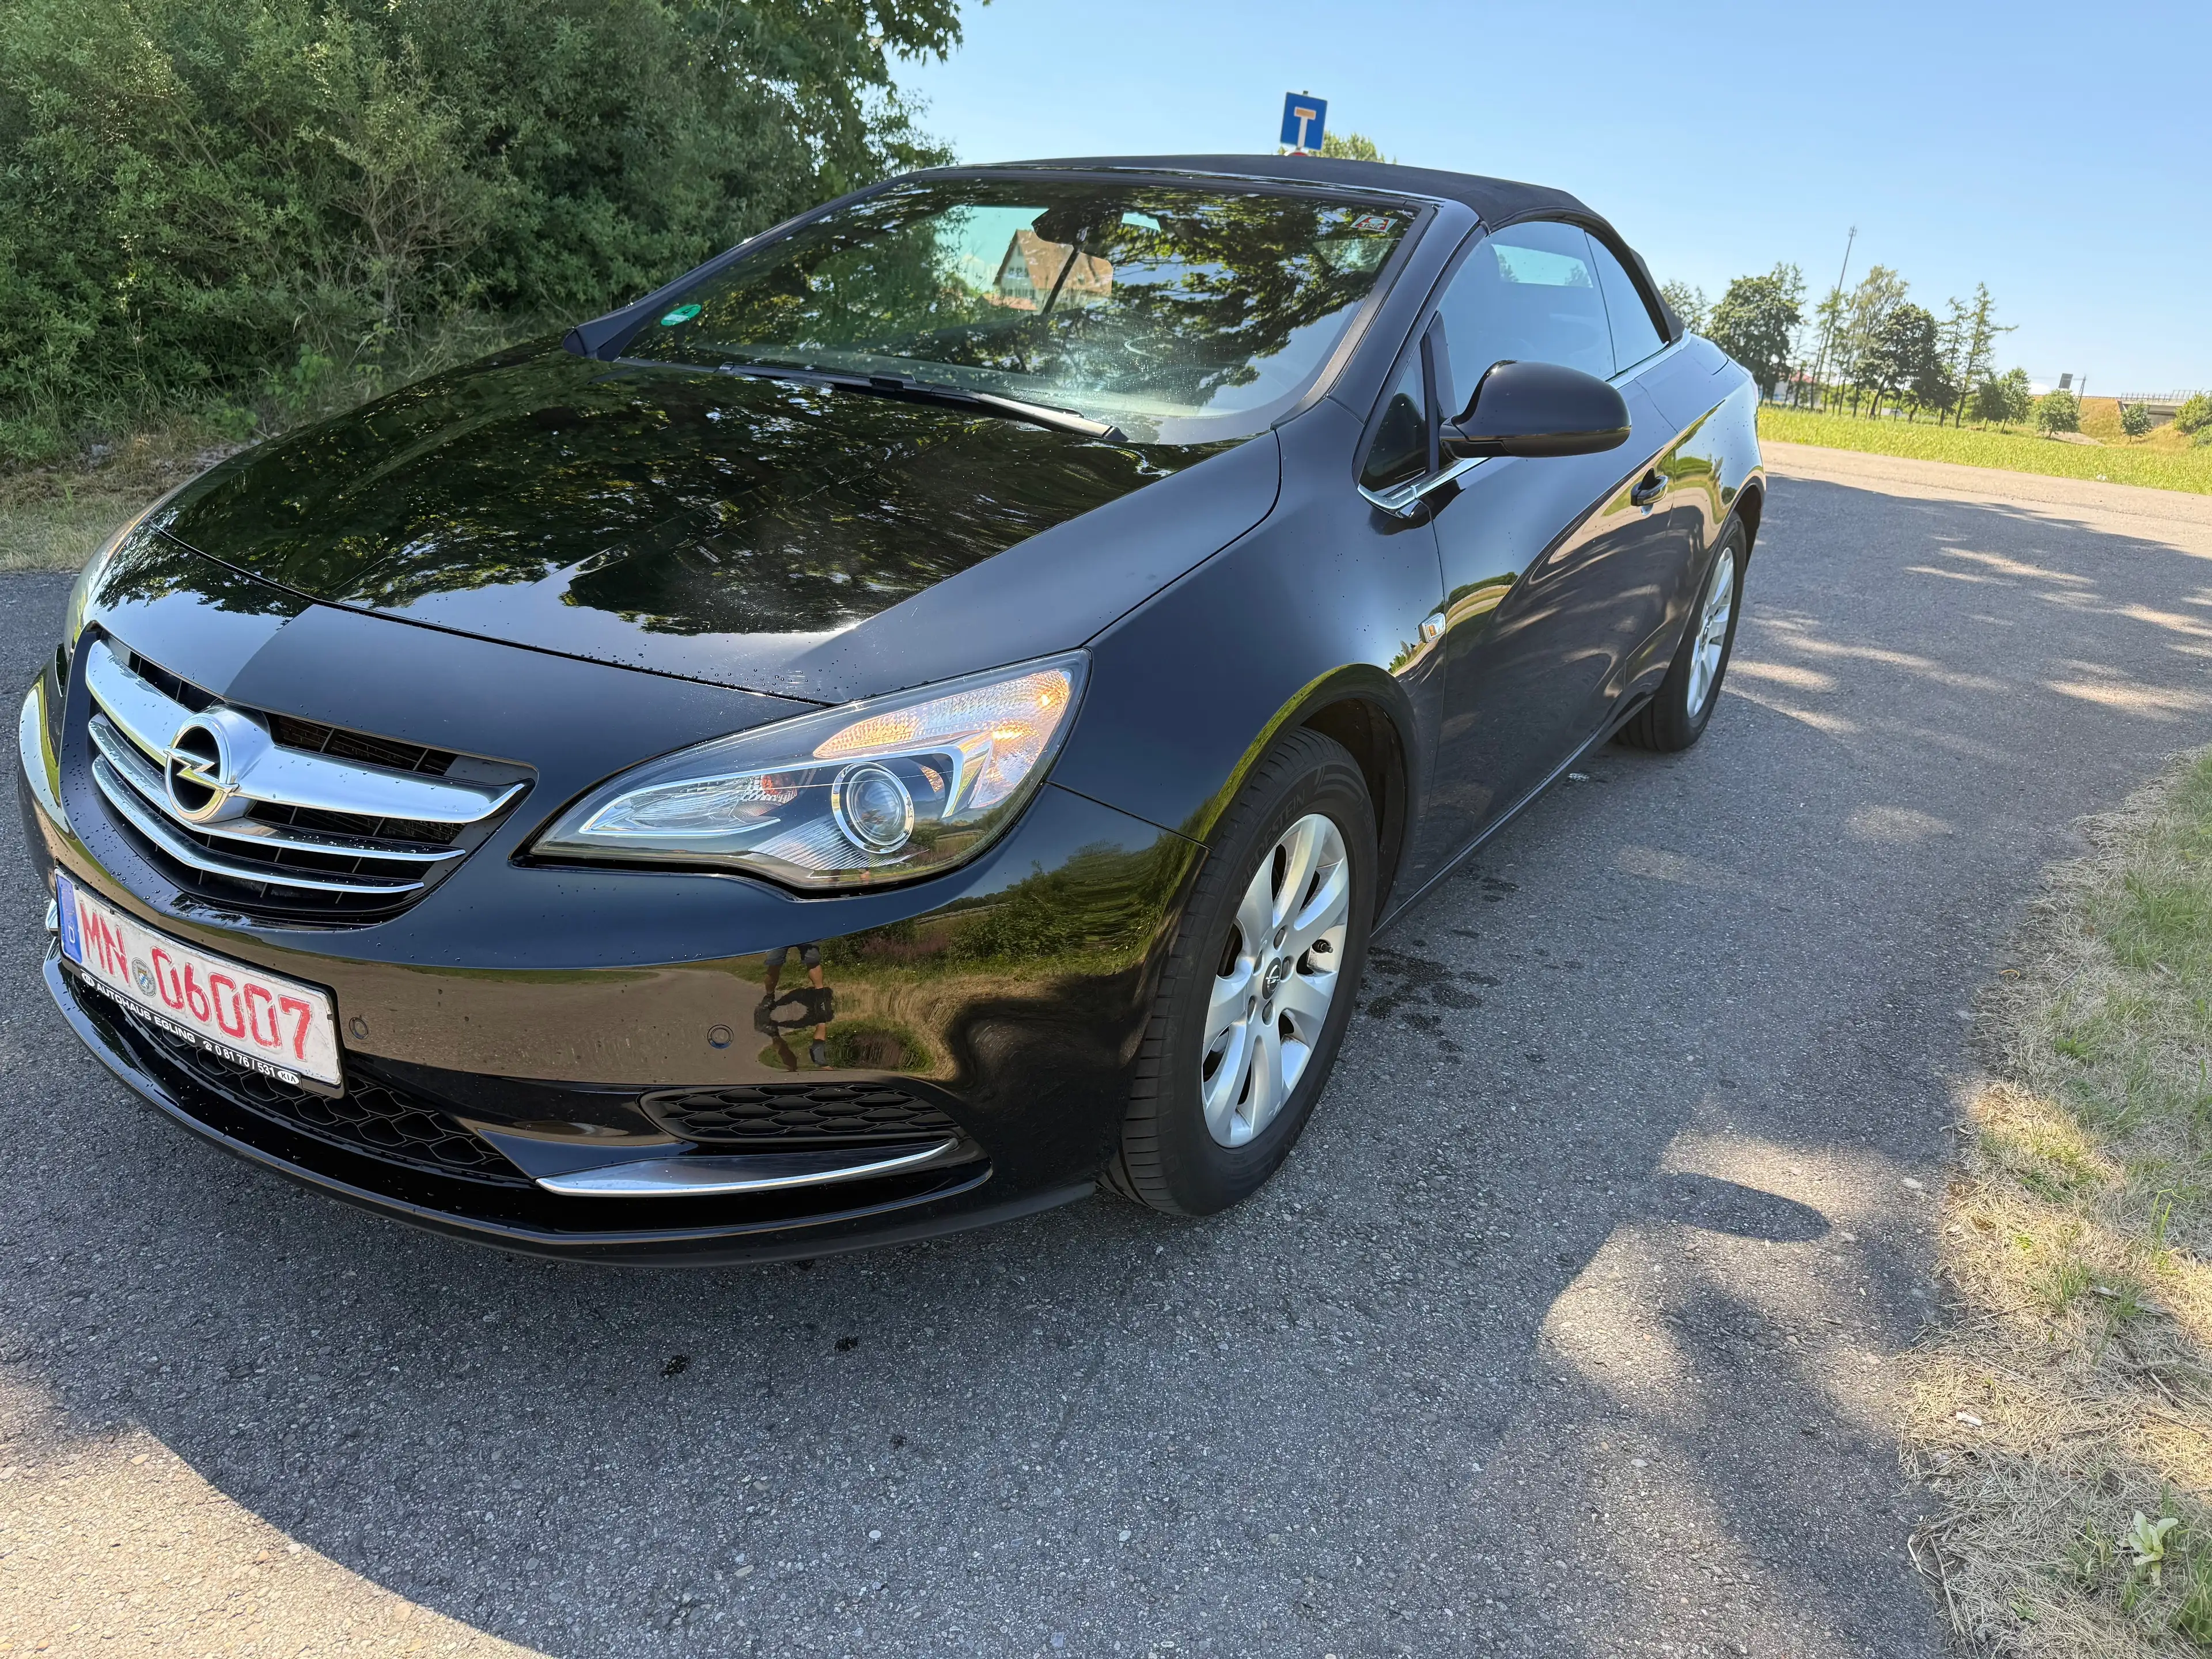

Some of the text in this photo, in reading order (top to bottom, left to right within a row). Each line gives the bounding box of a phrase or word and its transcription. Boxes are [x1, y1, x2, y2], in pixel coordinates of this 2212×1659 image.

[67, 925, 75, 944] D
[79, 900, 131, 986] MN
[151, 946, 314, 1062] 06007
[97, 983, 152, 1021] AUTOHAUS
[154, 1016, 196, 1043] EGLING
[257, 1062, 276, 1077] 531
[280, 1071, 297, 1084] KIA
